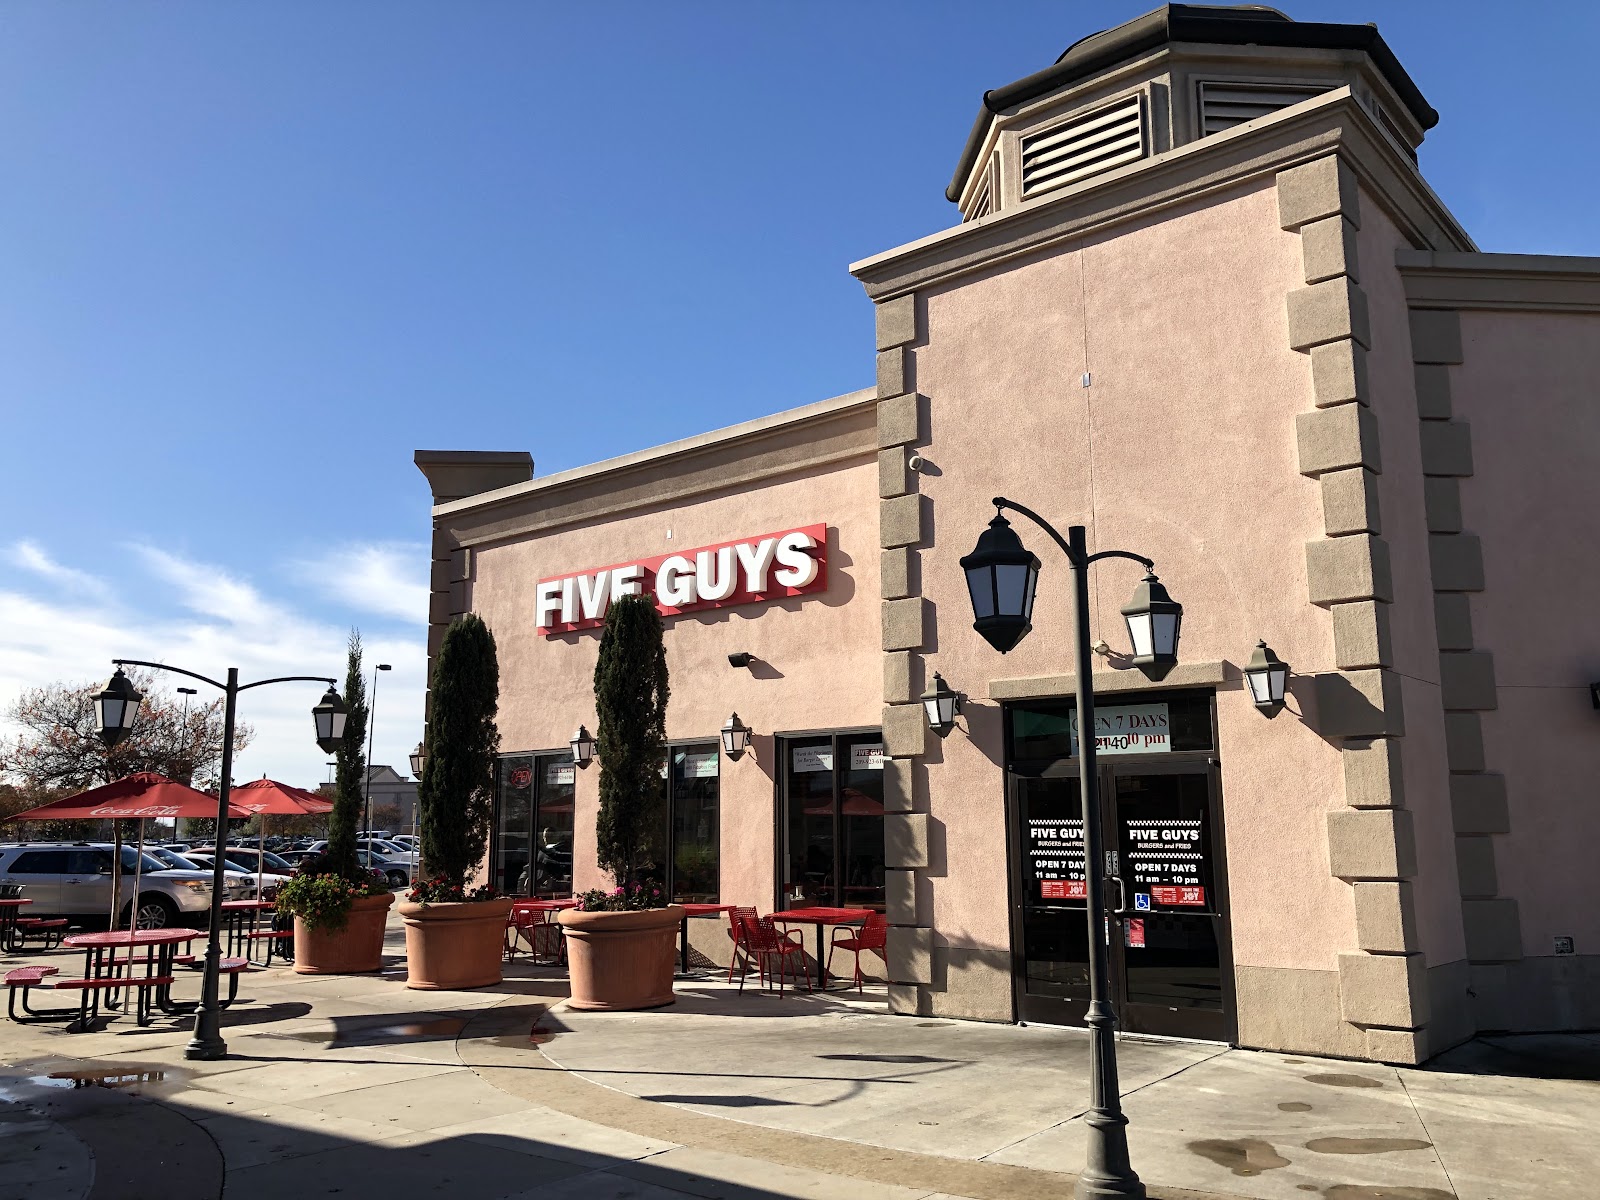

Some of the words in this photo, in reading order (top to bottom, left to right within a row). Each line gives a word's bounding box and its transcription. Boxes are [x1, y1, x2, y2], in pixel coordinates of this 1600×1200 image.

[535, 565, 645, 628] FIVE
[655, 532, 819, 607] GUYS
[1071, 716, 1111, 731] OEN
[1116, 715, 1123, 729] 7
[1128, 713, 1167, 728] DAYS
[1144, 734, 1166, 748] pm
[89, 805, 184, 816] Coca-Cola
[1030, 828, 1057, 839] FIVE
[1059, 828, 1085, 839] GUY
[1129, 829, 1159, 840] FIVE
[1161, 829, 1199, 841] GUYS
[1035, 859, 1060, 868] OPEN
[1060, 860, 1067, 869] 7
[1068, 861, 1086, 869] DAY
[1134, 862, 1162, 872] OPEN
[1162, 863, 1170, 872] 7
[1171, 863, 1197, 873] DAYS
[1035, 870, 1044, 879] 11
[1069, 871, 1079, 880] 10
[1134, 874, 1144, 883] 11
[1172, 875, 1183, 884] 10
[1184, 877, 1199, 885] pm
[1069, 886, 1084, 895] JOY
[1182, 892, 1199, 901] JOY
